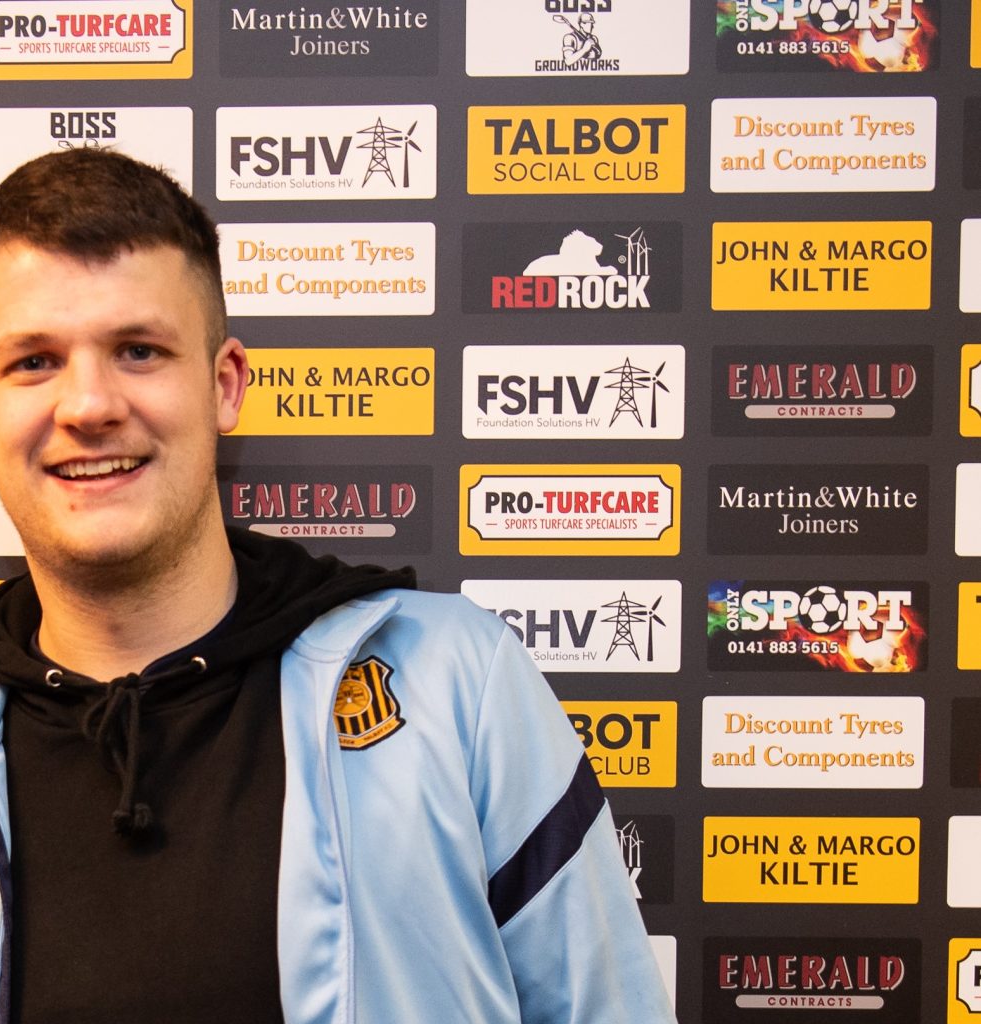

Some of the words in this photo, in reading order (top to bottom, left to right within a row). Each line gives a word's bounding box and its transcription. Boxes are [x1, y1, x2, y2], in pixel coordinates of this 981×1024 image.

[0, 14, 172, 38] PRO-TURFCARE
[231, 7, 428, 30] Martin&White
[19, 43, 51, 54] SPORTS
[53, 43, 97, 53] TURFCARE
[99, 42, 150, 53] SPECIALISTS
[290, 35, 370, 55] Joiners
[737, 42, 772, 54] 0141
[779, 42, 806, 53] 883
[812, 41, 850, 53] 5615
[51, 112, 116, 138] BOSS
[484, 118, 668, 155] TALBOT
[733, 116, 842, 136] Discount
[851, 115, 914, 140] Tyres
[231, 136, 352, 177] FSHV
[721, 152, 765, 170] and
[773, 150, 926, 174] Components
[494, 162, 584, 182] SOCIAL
[594, 161, 658, 181] CLUB
[230, 179, 287, 189] Foundation
[290, 179, 335, 189] Solutions
[338, 179, 353, 188] HV
[237, 240, 344, 262] Discount
[351, 240, 414, 266] Tyres
[716, 241, 789, 263] JOHN
[799, 241, 817, 260] &
[827, 240, 927, 260] MARGO
[225, 273, 268, 295] and
[276, 273, 426, 298] Components
[491, 275, 650, 308] REDROCK
[769, 268, 869, 292] KILTIE
[305, 367, 322, 386] &
[333, 366, 430, 386] MARGO
[728, 362, 917, 400] EMERALD
[277, 394, 373, 417] KILTIE
[477, 375, 600, 414] FSHV
[476, 418, 533, 428] Foundation
[537, 418, 582, 427] Solutions
[585, 418, 600, 427] HV
[777, 406, 864, 417] CONTRACTS
[231, 483, 416, 518] EMERALD
[485, 491, 659, 514] PRO-TURFCARE
[719, 486, 917, 508] Martin&White
[280, 525, 364, 534] CONTRACTS
[505, 519, 537, 530] SPORTS
[540, 519, 583, 530] TURFCARE
[586, 519, 637, 530] SPECIALISTS
[779, 514, 859, 534] Joiners
[726, 590, 738, 630] ONLY
[727, 641, 764, 654] 0141
[770, 641, 796, 654] 883
[801, 641, 838, 654] 5615
[725, 713, 834, 735] Discount
[840, 713, 903, 738] Tyres
[712, 747, 756, 766] and
[763, 747, 914, 770] Components
[708, 835, 779, 857] JOHN
[789, 836, 807, 854] &
[817, 835, 915, 855] MARGO
[760, 862, 859, 885] KILTIE
[719, 954, 904, 990] EMERALD
[767, 997, 852, 1007] CONTRACTS
